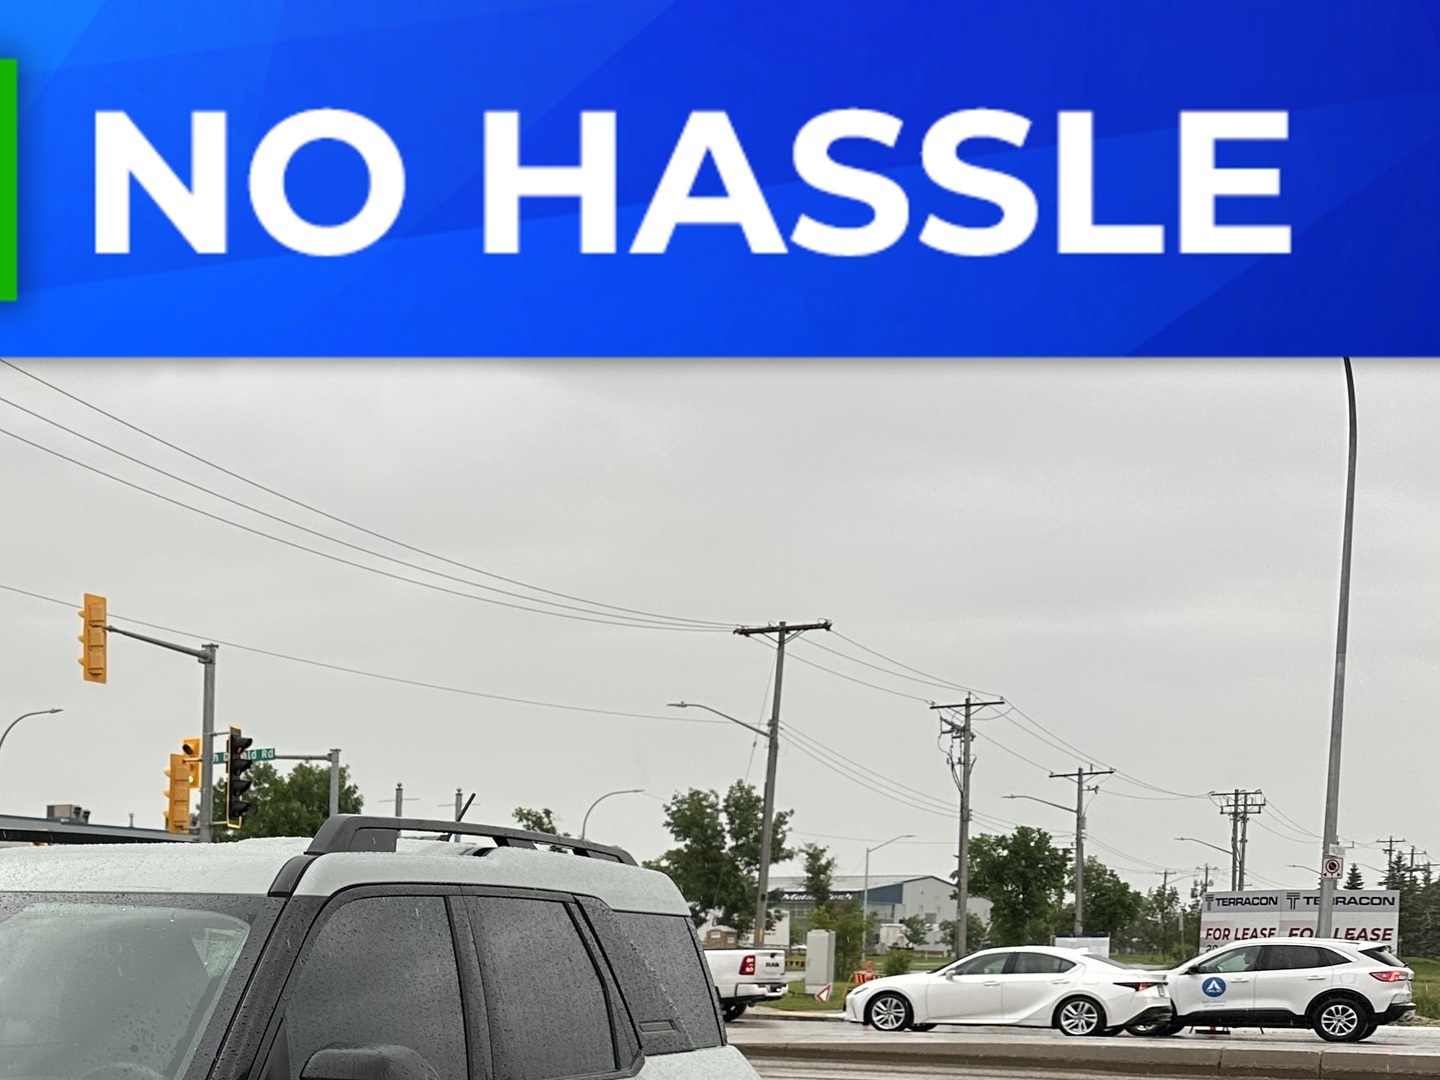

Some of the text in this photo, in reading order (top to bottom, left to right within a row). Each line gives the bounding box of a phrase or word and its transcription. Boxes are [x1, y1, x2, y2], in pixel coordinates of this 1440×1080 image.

[261, 749, 273, 758] Rd
[1216, 896, 1278, 906] TERRACON
[1205, 928, 1277, 940] FOR LEASE
[1334, 928, 1394, 941] LEASE
